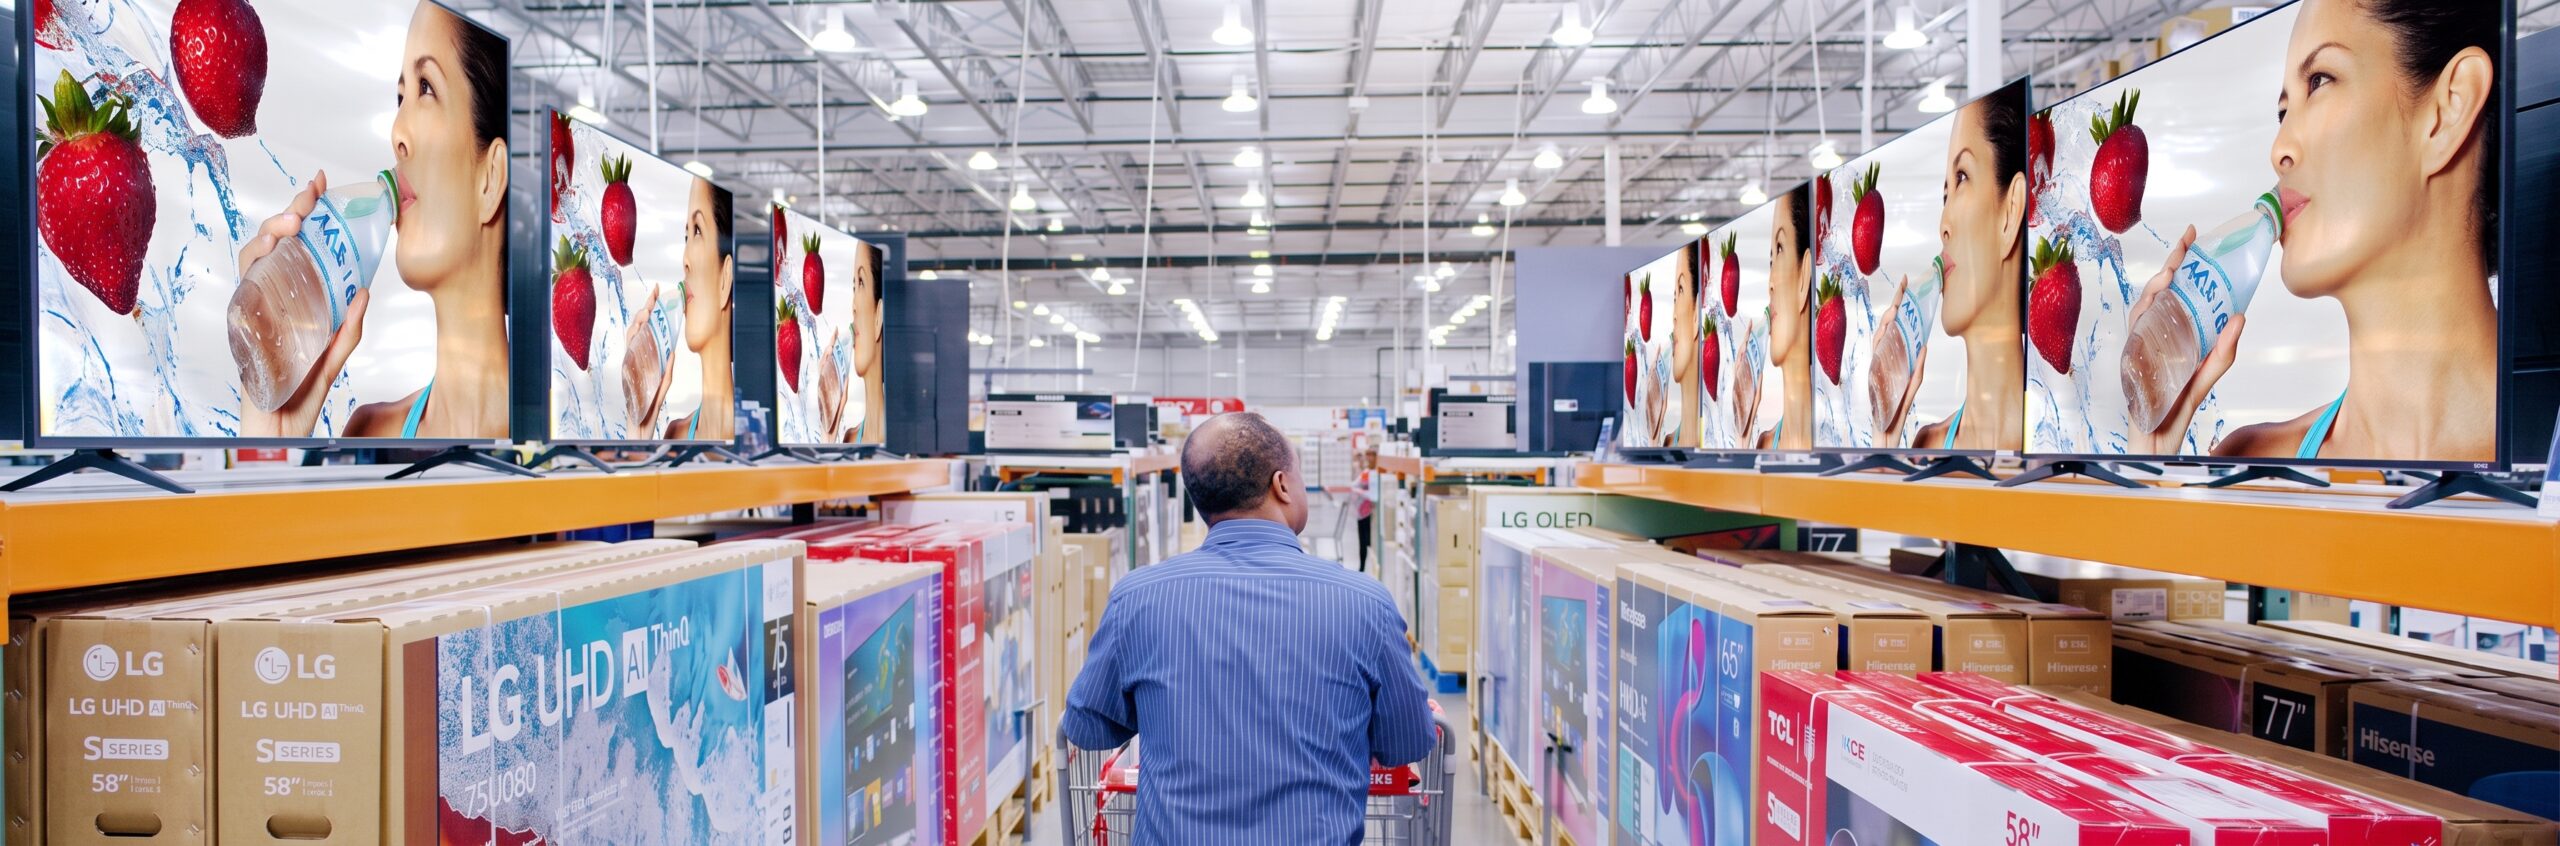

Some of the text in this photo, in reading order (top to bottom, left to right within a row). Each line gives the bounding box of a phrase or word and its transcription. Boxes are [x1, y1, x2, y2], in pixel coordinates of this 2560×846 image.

[1502, 511, 1593, 528] LG OLED
[125, 651, 164, 677] LG
[297, 654, 336, 680] LG
[461, 615, 689, 756] LG UHD AI ThinQ
[69, 698, 96, 715] LG
[102, 698, 145, 716] UHD
[150, 702, 165, 715] AI
[241, 701, 268, 718] LG
[274, 701, 318, 720] UHD
[322, 705, 337, 718] AI
[1768, 709, 1794, 747] TCL
[83, 736, 164, 761] S SERIES
[256, 738, 336, 763] S SERIES
[2360, 727, 2435, 767] Hisense
[464, 761, 537, 819] 75U080
